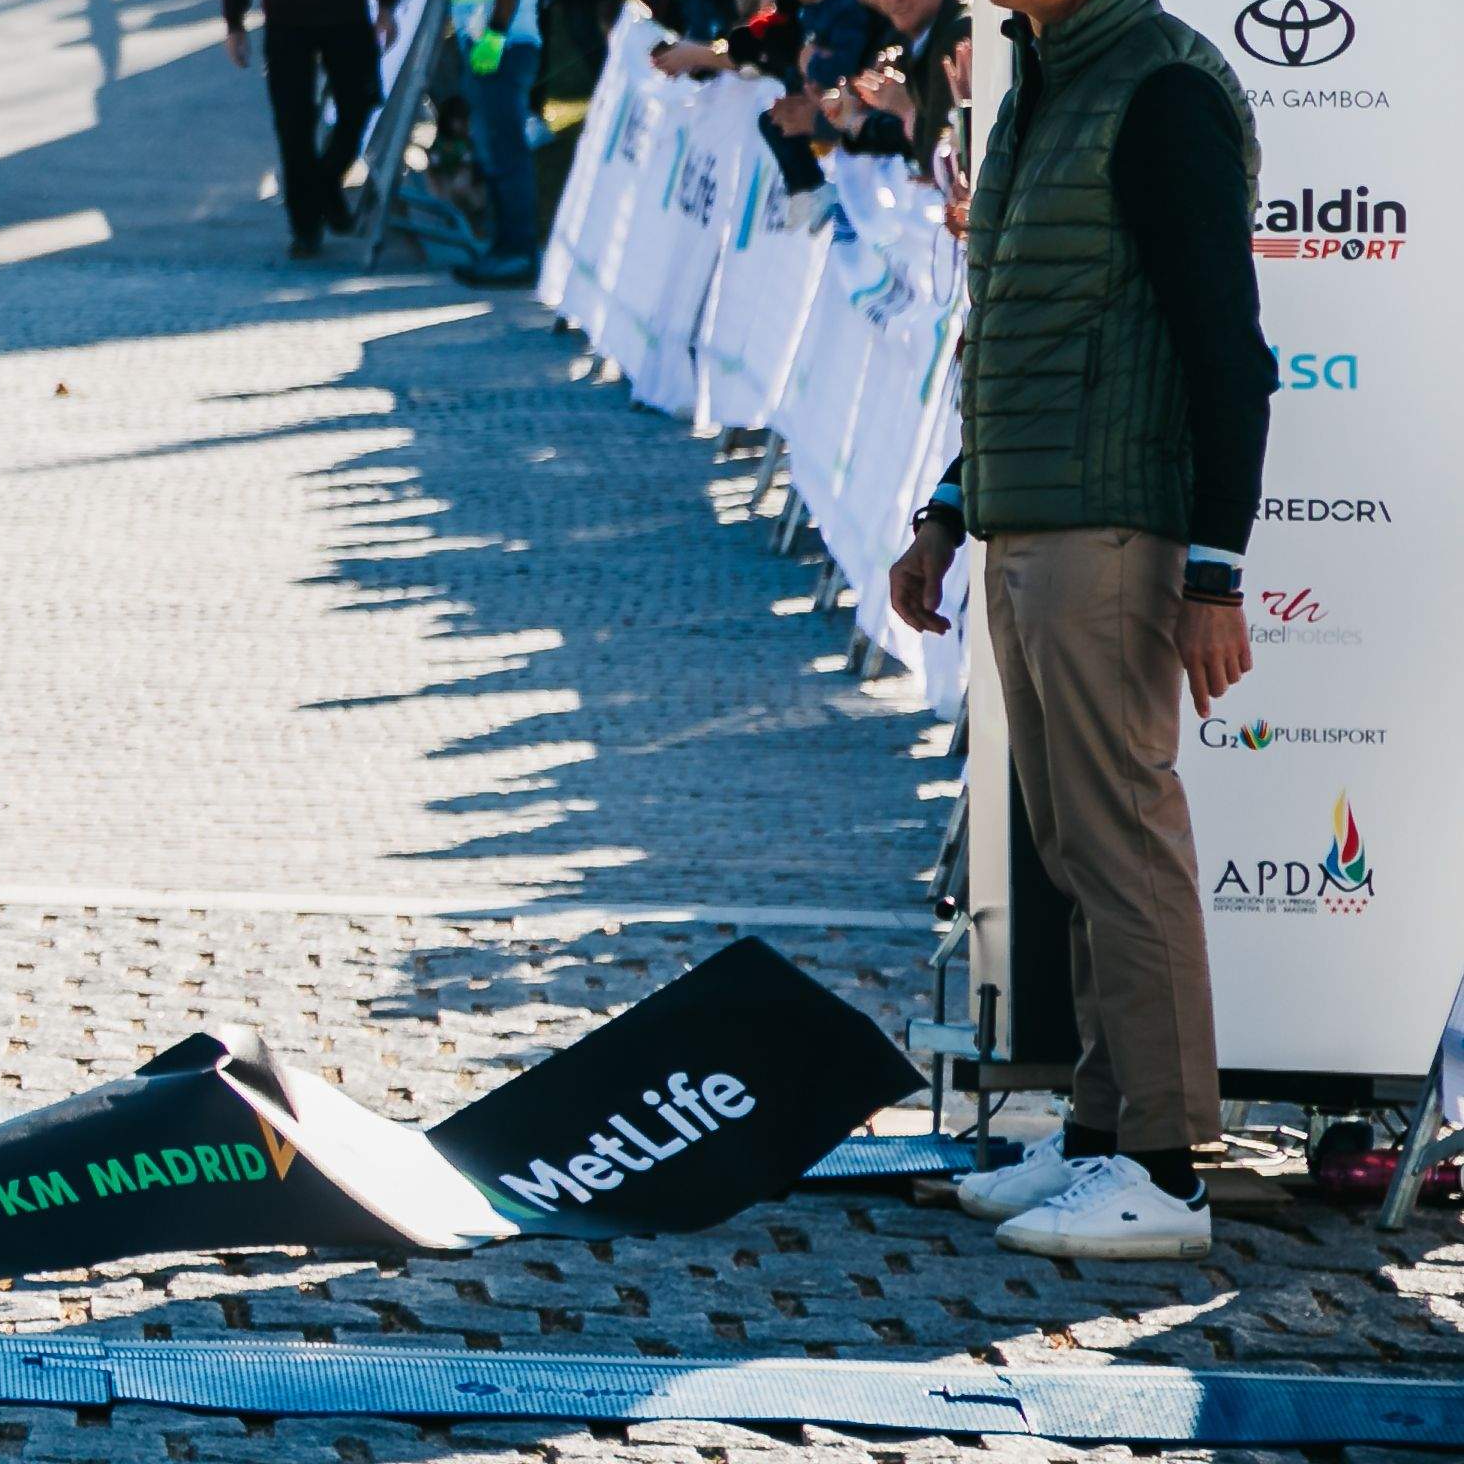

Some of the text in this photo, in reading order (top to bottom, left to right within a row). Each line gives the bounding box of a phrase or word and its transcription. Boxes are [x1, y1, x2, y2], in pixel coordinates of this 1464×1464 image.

[1282, 89, 1390, 109] GAMBOA
[1253, 185, 1407, 234] aldin
[1300, 238, 1407, 261] SPORT
[1274, 726, 1388, 746] PUBLISPORT
[499, 1061, 758, 1220] MetLife
[85, 1141, 269, 1198] MADRID
